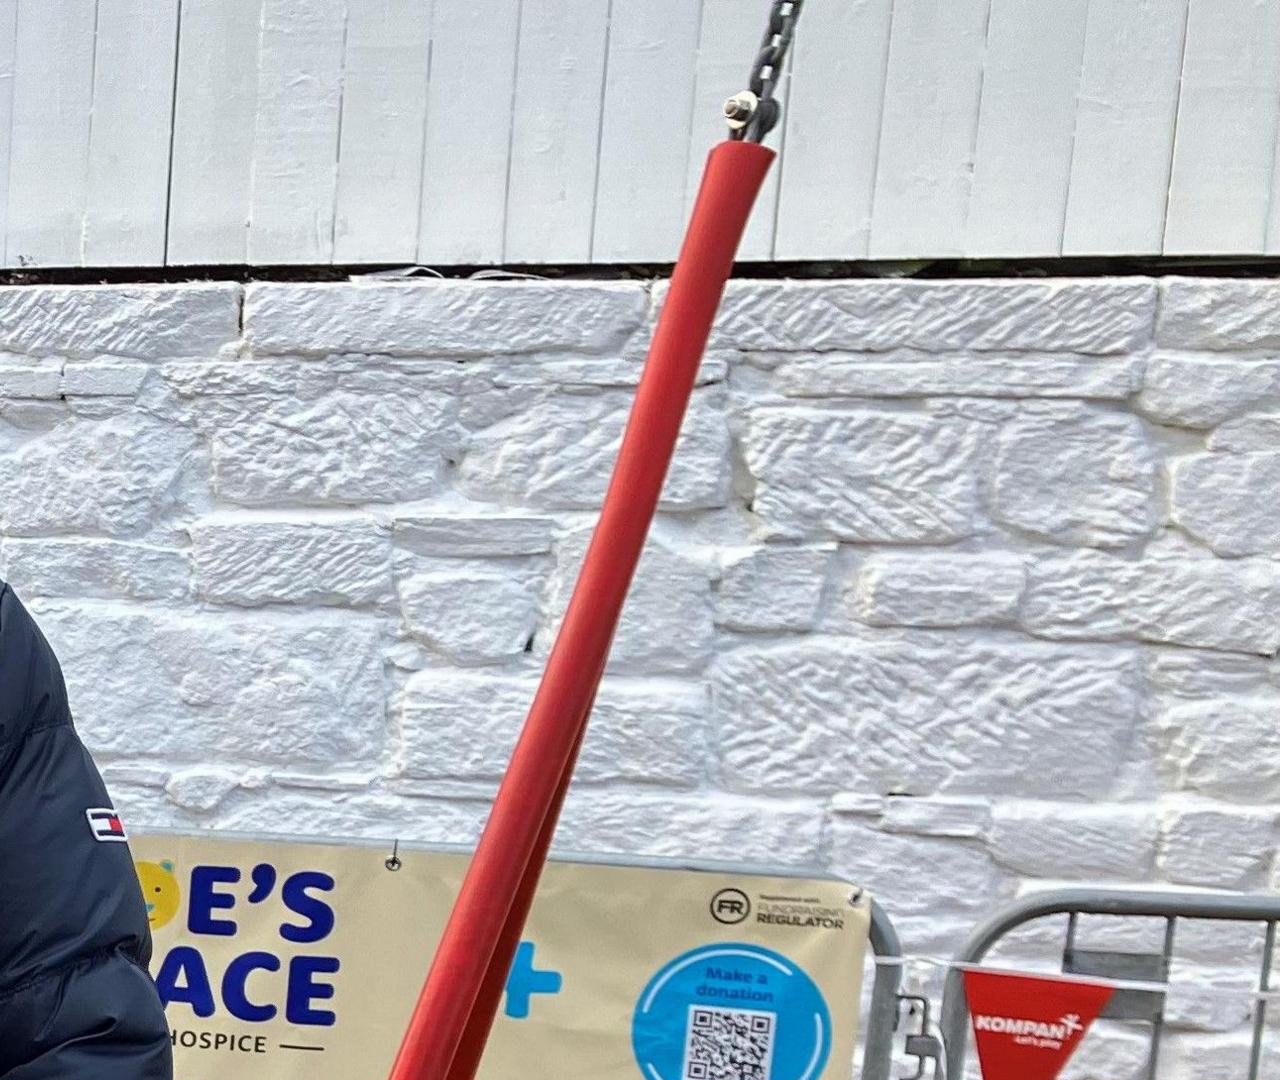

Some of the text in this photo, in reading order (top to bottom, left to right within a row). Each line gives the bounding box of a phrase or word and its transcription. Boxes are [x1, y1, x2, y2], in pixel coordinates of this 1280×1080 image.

[188, 863, 336, 943] E'S
[757, 912, 844, 929] REGULATOR
[705, 966, 768, 985] Make a
[155, 945, 340, 1027] ACE
[696, 984, 774, 1002] donation
